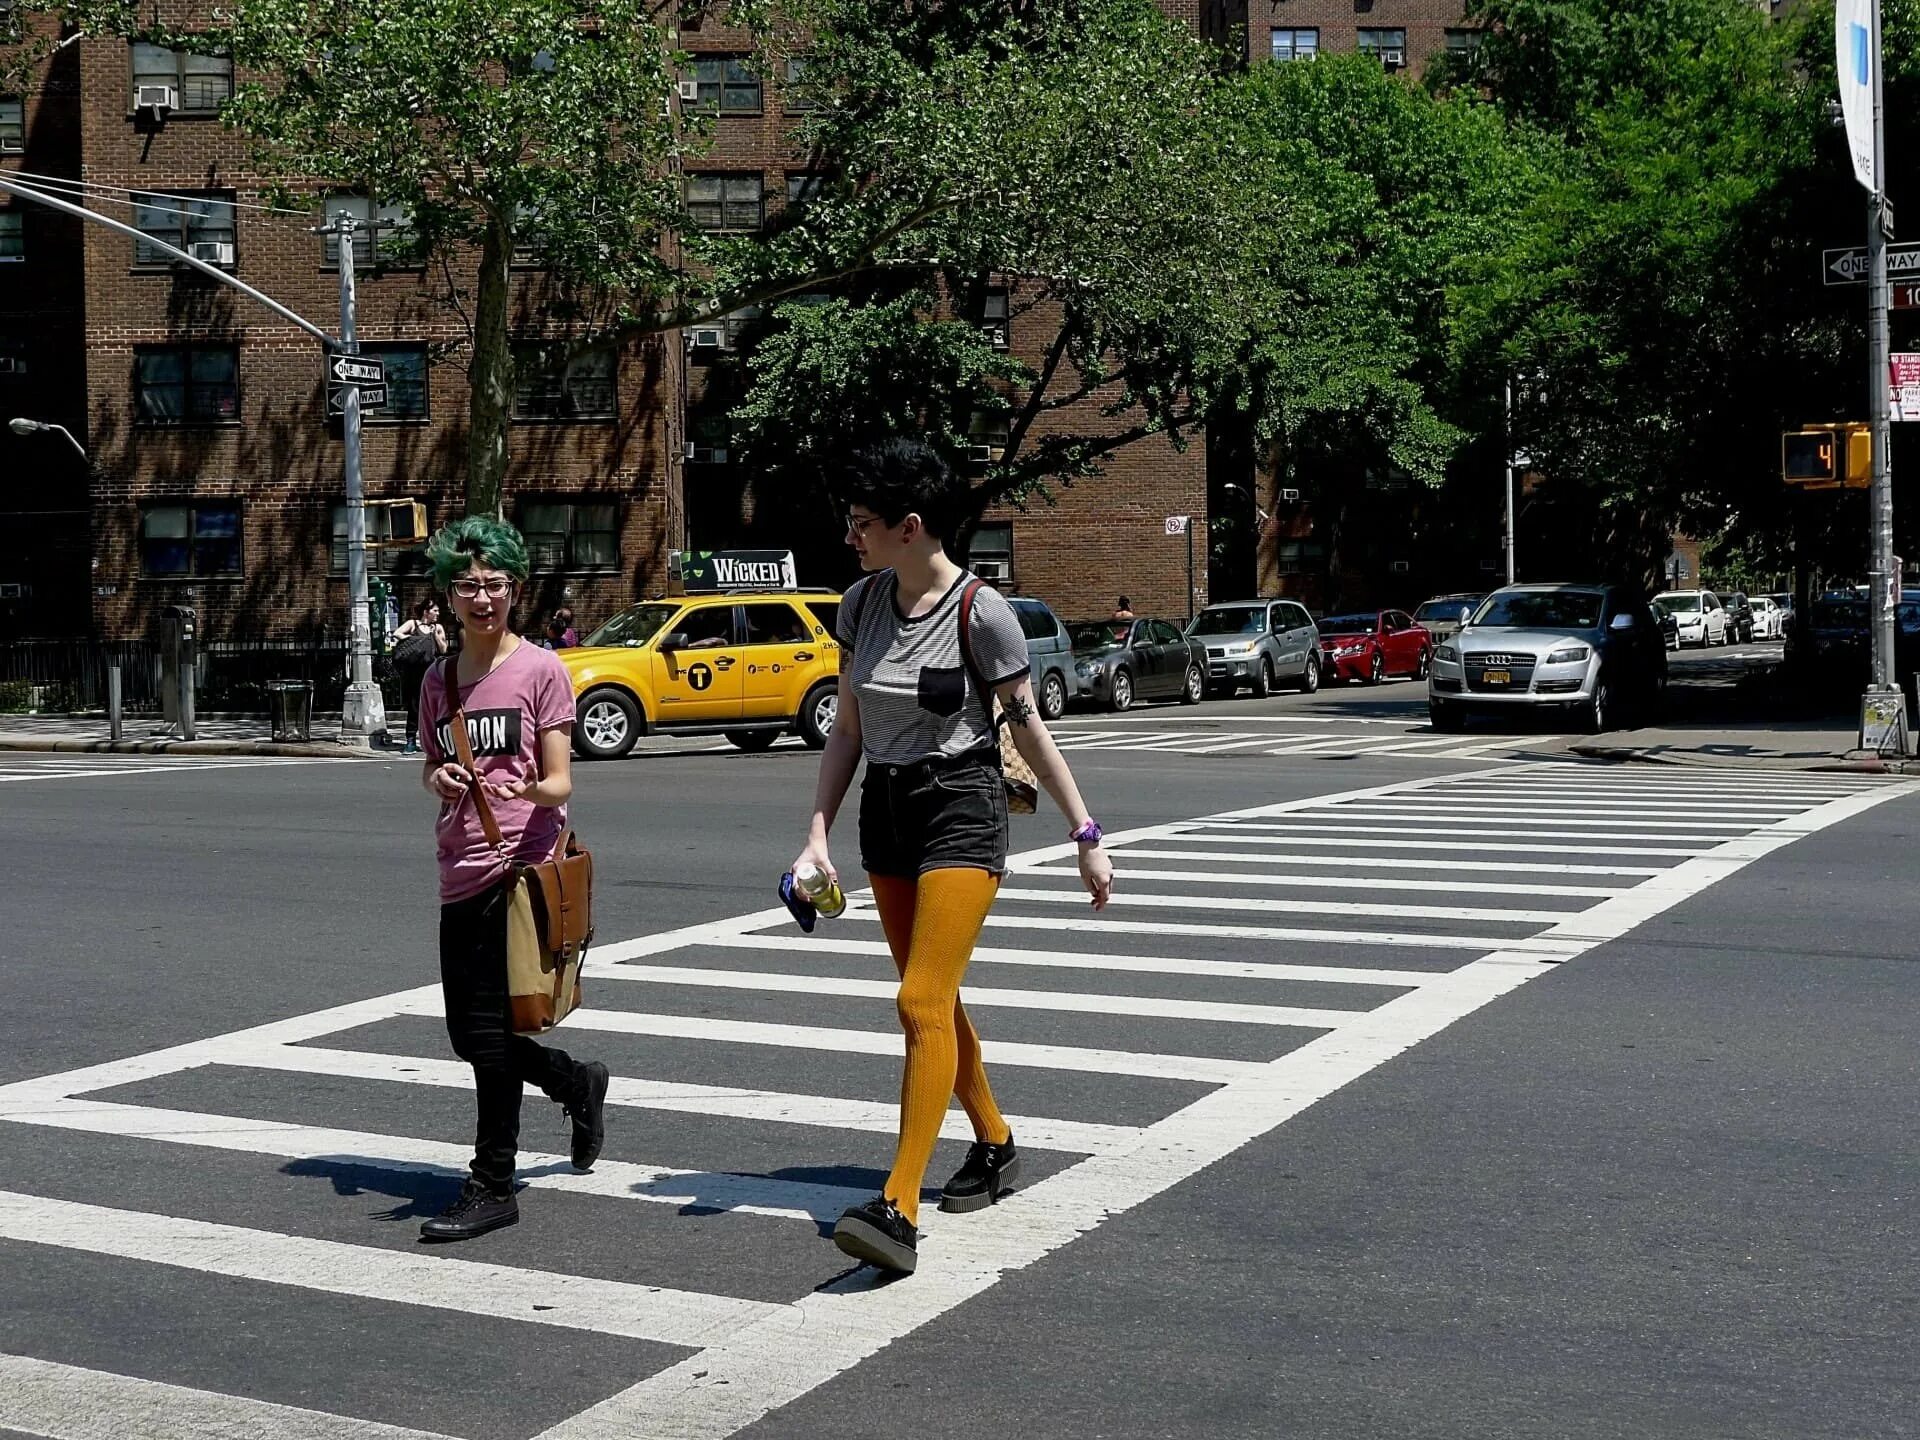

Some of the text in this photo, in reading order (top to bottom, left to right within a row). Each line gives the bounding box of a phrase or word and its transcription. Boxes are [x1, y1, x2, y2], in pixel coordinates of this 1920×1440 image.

[1841, 253, 1918, 273] ONE WAY
[338, 364, 377, 379] ONE WAY
[360, 392, 379, 403] WAY
[1890, 389, 1901, 401] NO
[1820, 444, 1831, 470] 4
[711, 558, 780, 582] WICKED
[692, 668, 707, 688] T
[436, 716, 507, 759] ODON
